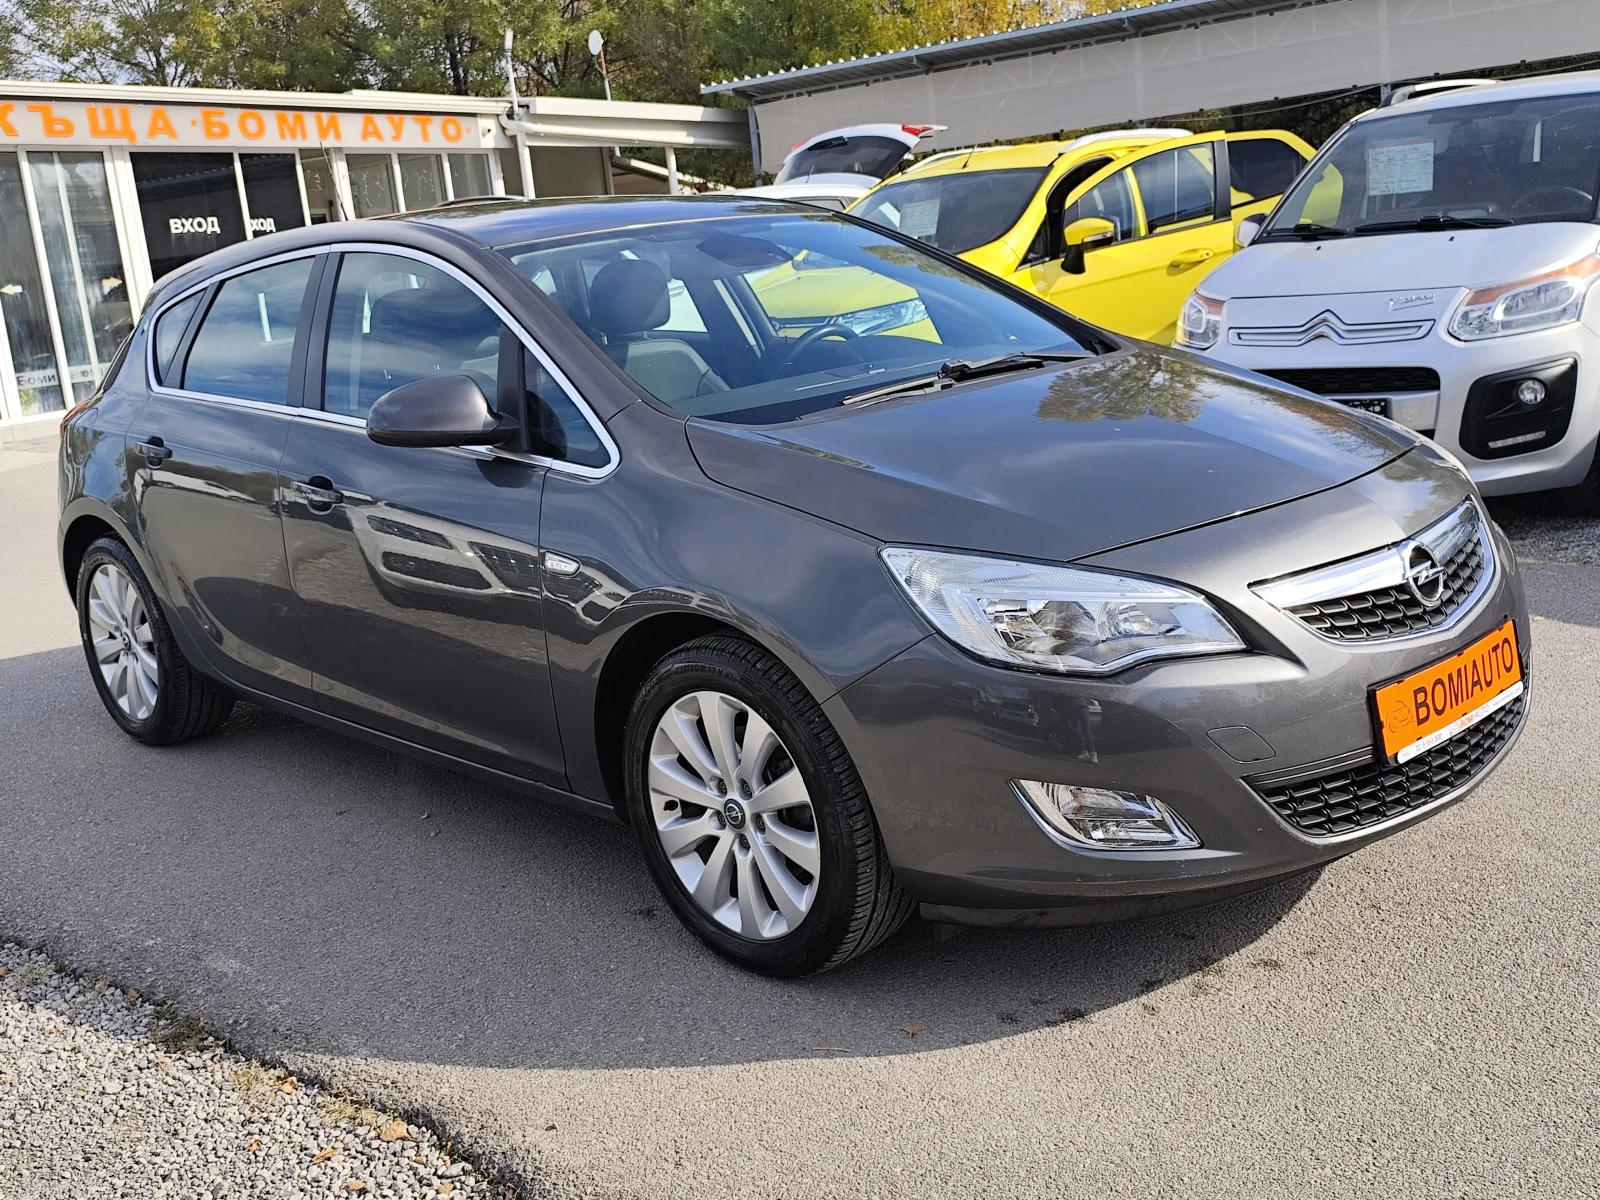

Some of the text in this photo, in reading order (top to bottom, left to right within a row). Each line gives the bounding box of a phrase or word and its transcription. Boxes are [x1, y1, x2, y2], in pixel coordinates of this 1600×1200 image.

[201, 108, 342, 142] БОМИ
[360, 112, 463, 143] АУТО
[169, 216, 221, 235] ВХОД
[250, 218, 276, 233] ХОД
[1413, 637, 1513, 727] BOMIAUTO
